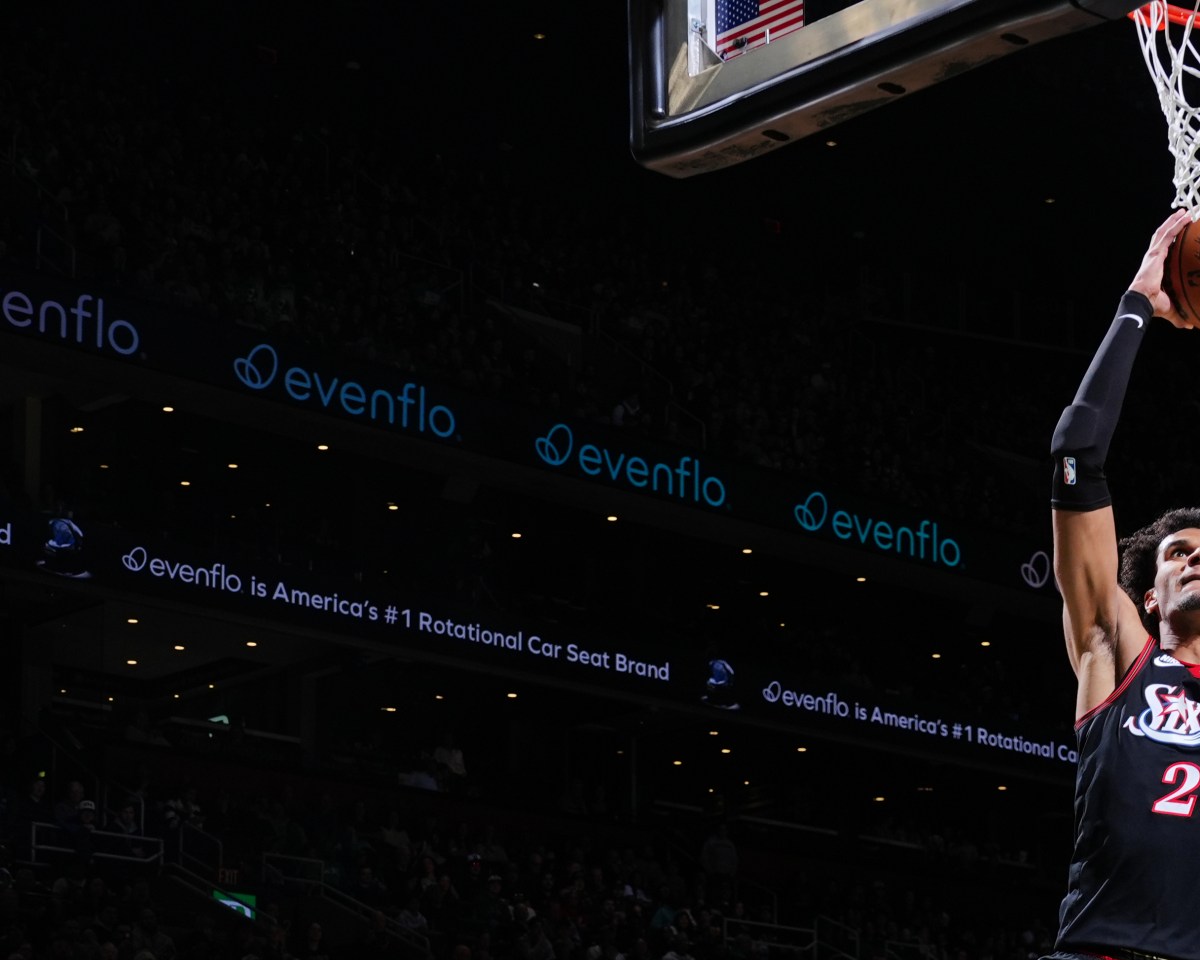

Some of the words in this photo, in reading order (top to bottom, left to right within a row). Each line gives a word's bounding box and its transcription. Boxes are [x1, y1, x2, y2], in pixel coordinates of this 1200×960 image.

[1, 290, 140, 355] enflo
[284, 366, 456, 438] evenflo
[578, 444, 726, 507] evenflo
[831, 510, 961, 567] evenflo
[149, 558, 242, 593] evenflo
[251, 575, 267, 598] is
[272, 581, 379, 621] America's
[384, 605, 411, 628] #1
[419, 611, 523, 651] Rotational
[527, 635, 562, 659] Car
[566, 643, 610, 669] Seat
[615, 653, 670, 681] Brand
[782, 690, 850, 717] evenflo
[854, 702, 868, 721] is
[871, 707, 949, 737] America's
[952, 723, 972, 742] #1
[977, 727, 1055, 759] Rotational
[1058, 744, 1079, 764] Ca
